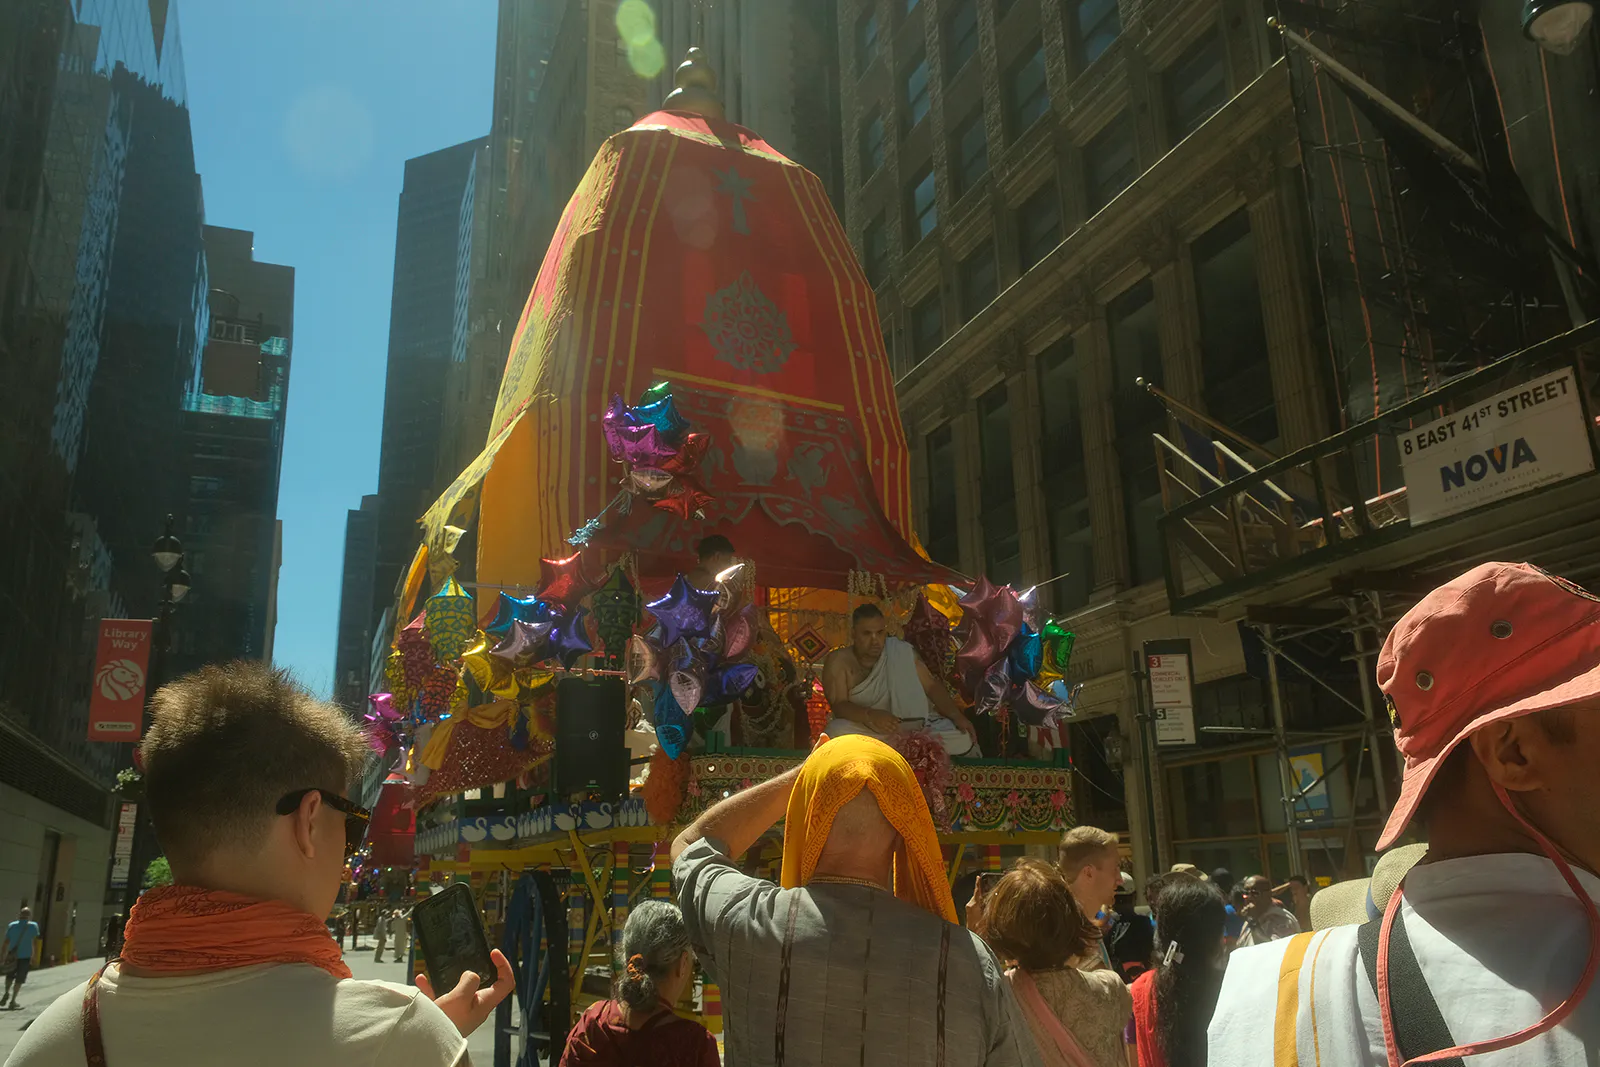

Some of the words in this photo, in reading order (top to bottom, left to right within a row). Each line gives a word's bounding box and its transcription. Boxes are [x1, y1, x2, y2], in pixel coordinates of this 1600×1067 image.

[1403, 439, 1413, 455] 8
[1416, 421, 1457, 451] EAST
[1462, 405, 1492, 432] 41ST
[1497, 376, 1569, 418] STREET
[1440, 437, 1538, 492] NOVA
[104, 628, 148, 641] Library
[112, 639, 138, 651] Way
[1151, 657, 1158, 667] 3
